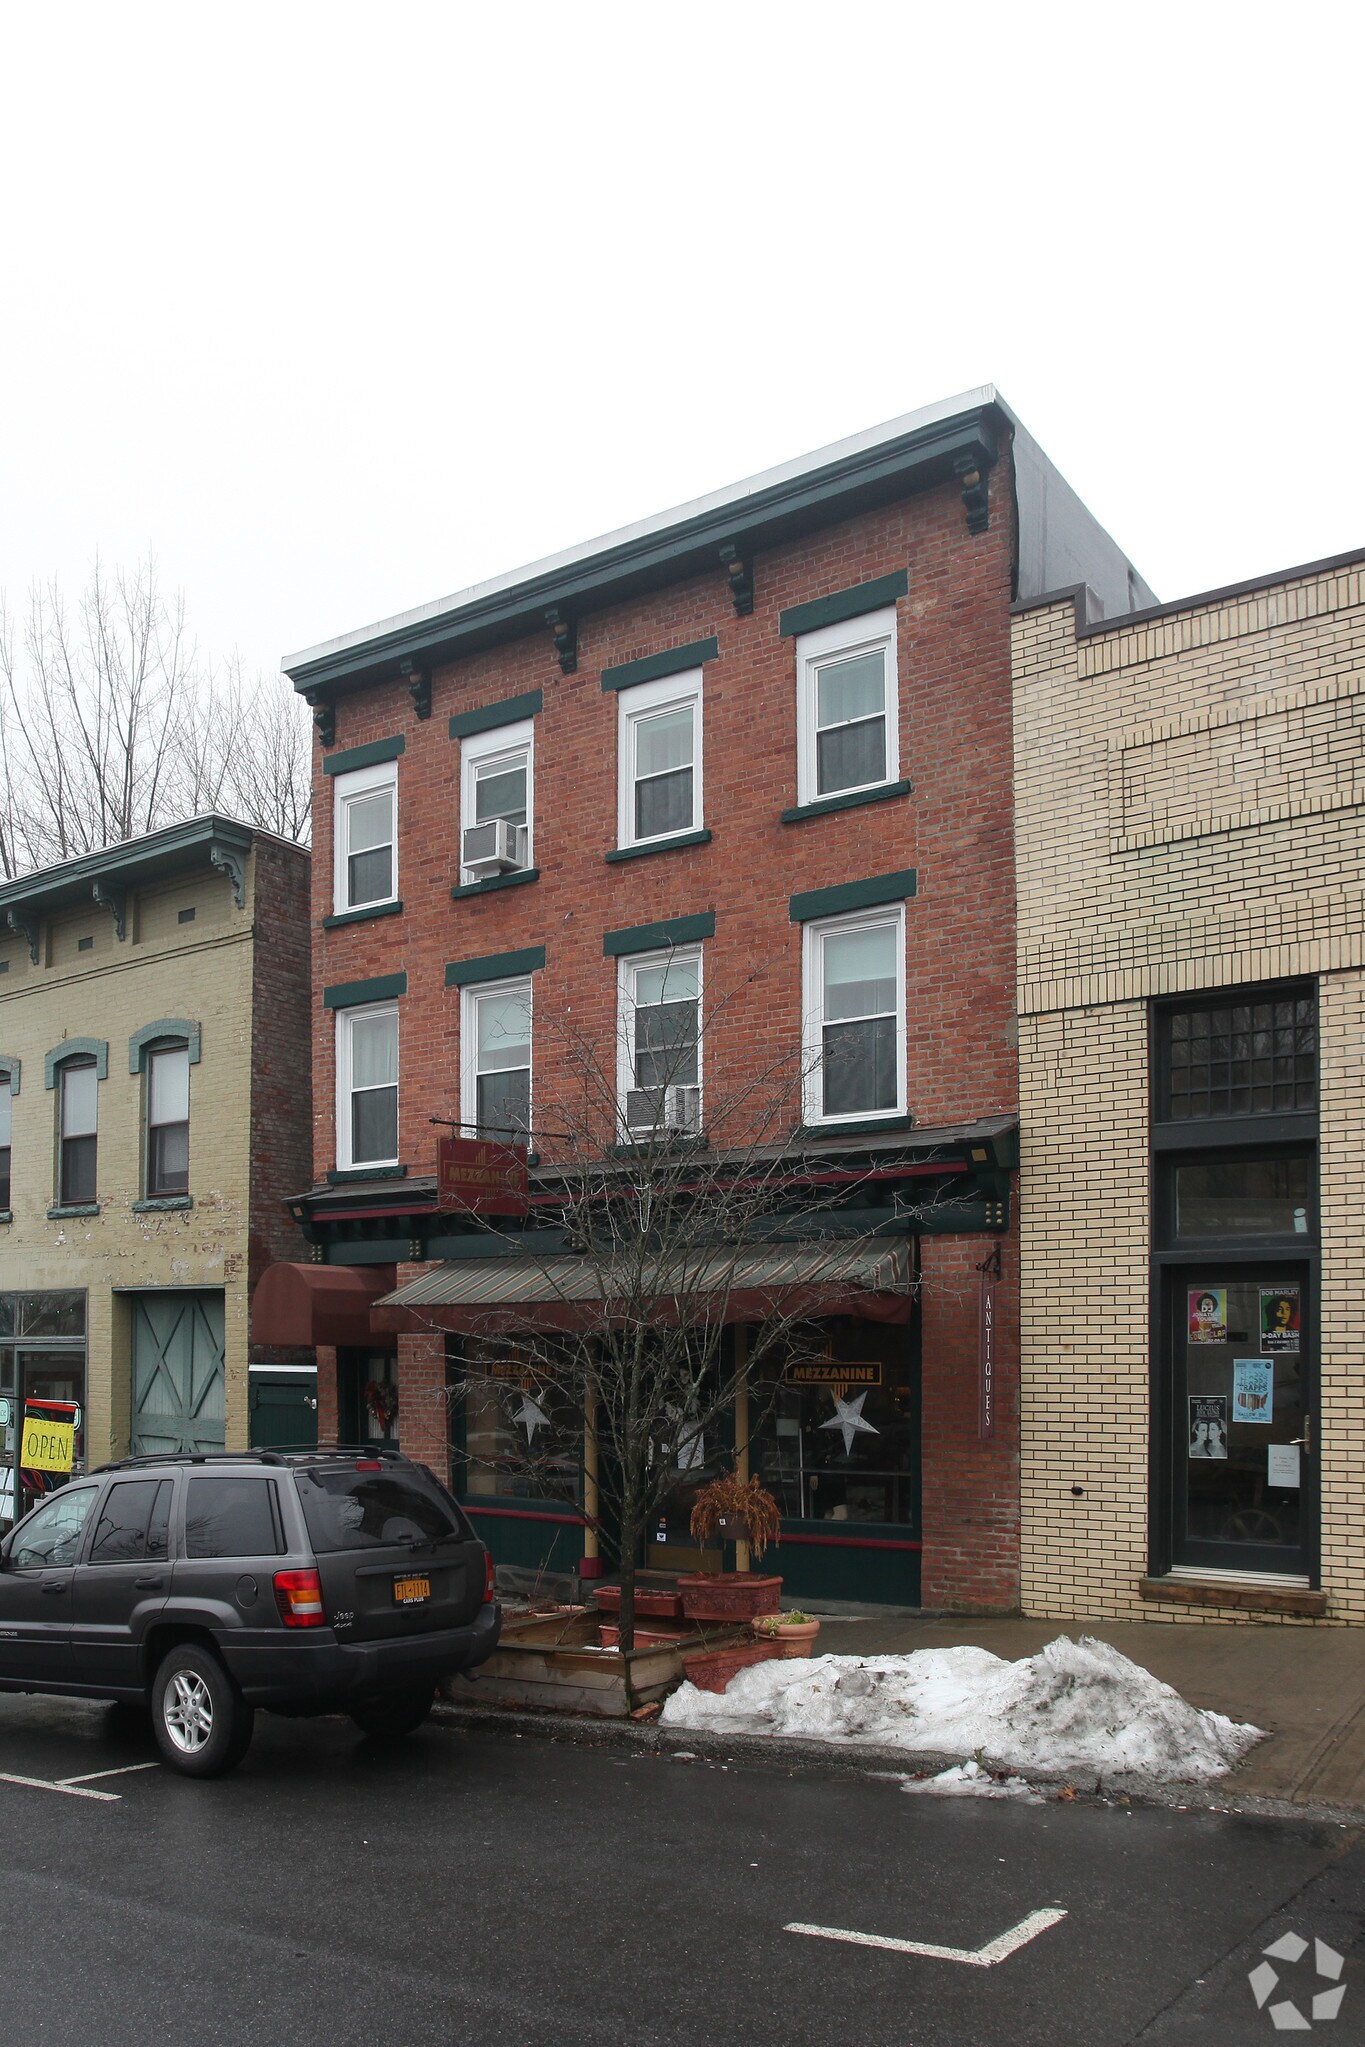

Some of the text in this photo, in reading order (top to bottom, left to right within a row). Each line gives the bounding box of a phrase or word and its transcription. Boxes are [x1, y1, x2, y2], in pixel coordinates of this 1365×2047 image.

[1201, 1305, 1213, 1313] DJ
[793, 1367, 874, 1380] MEZZANINE
[27, 1432, 69, 1461] OPEN
[334, 1610, 354, 1620] Jeep
